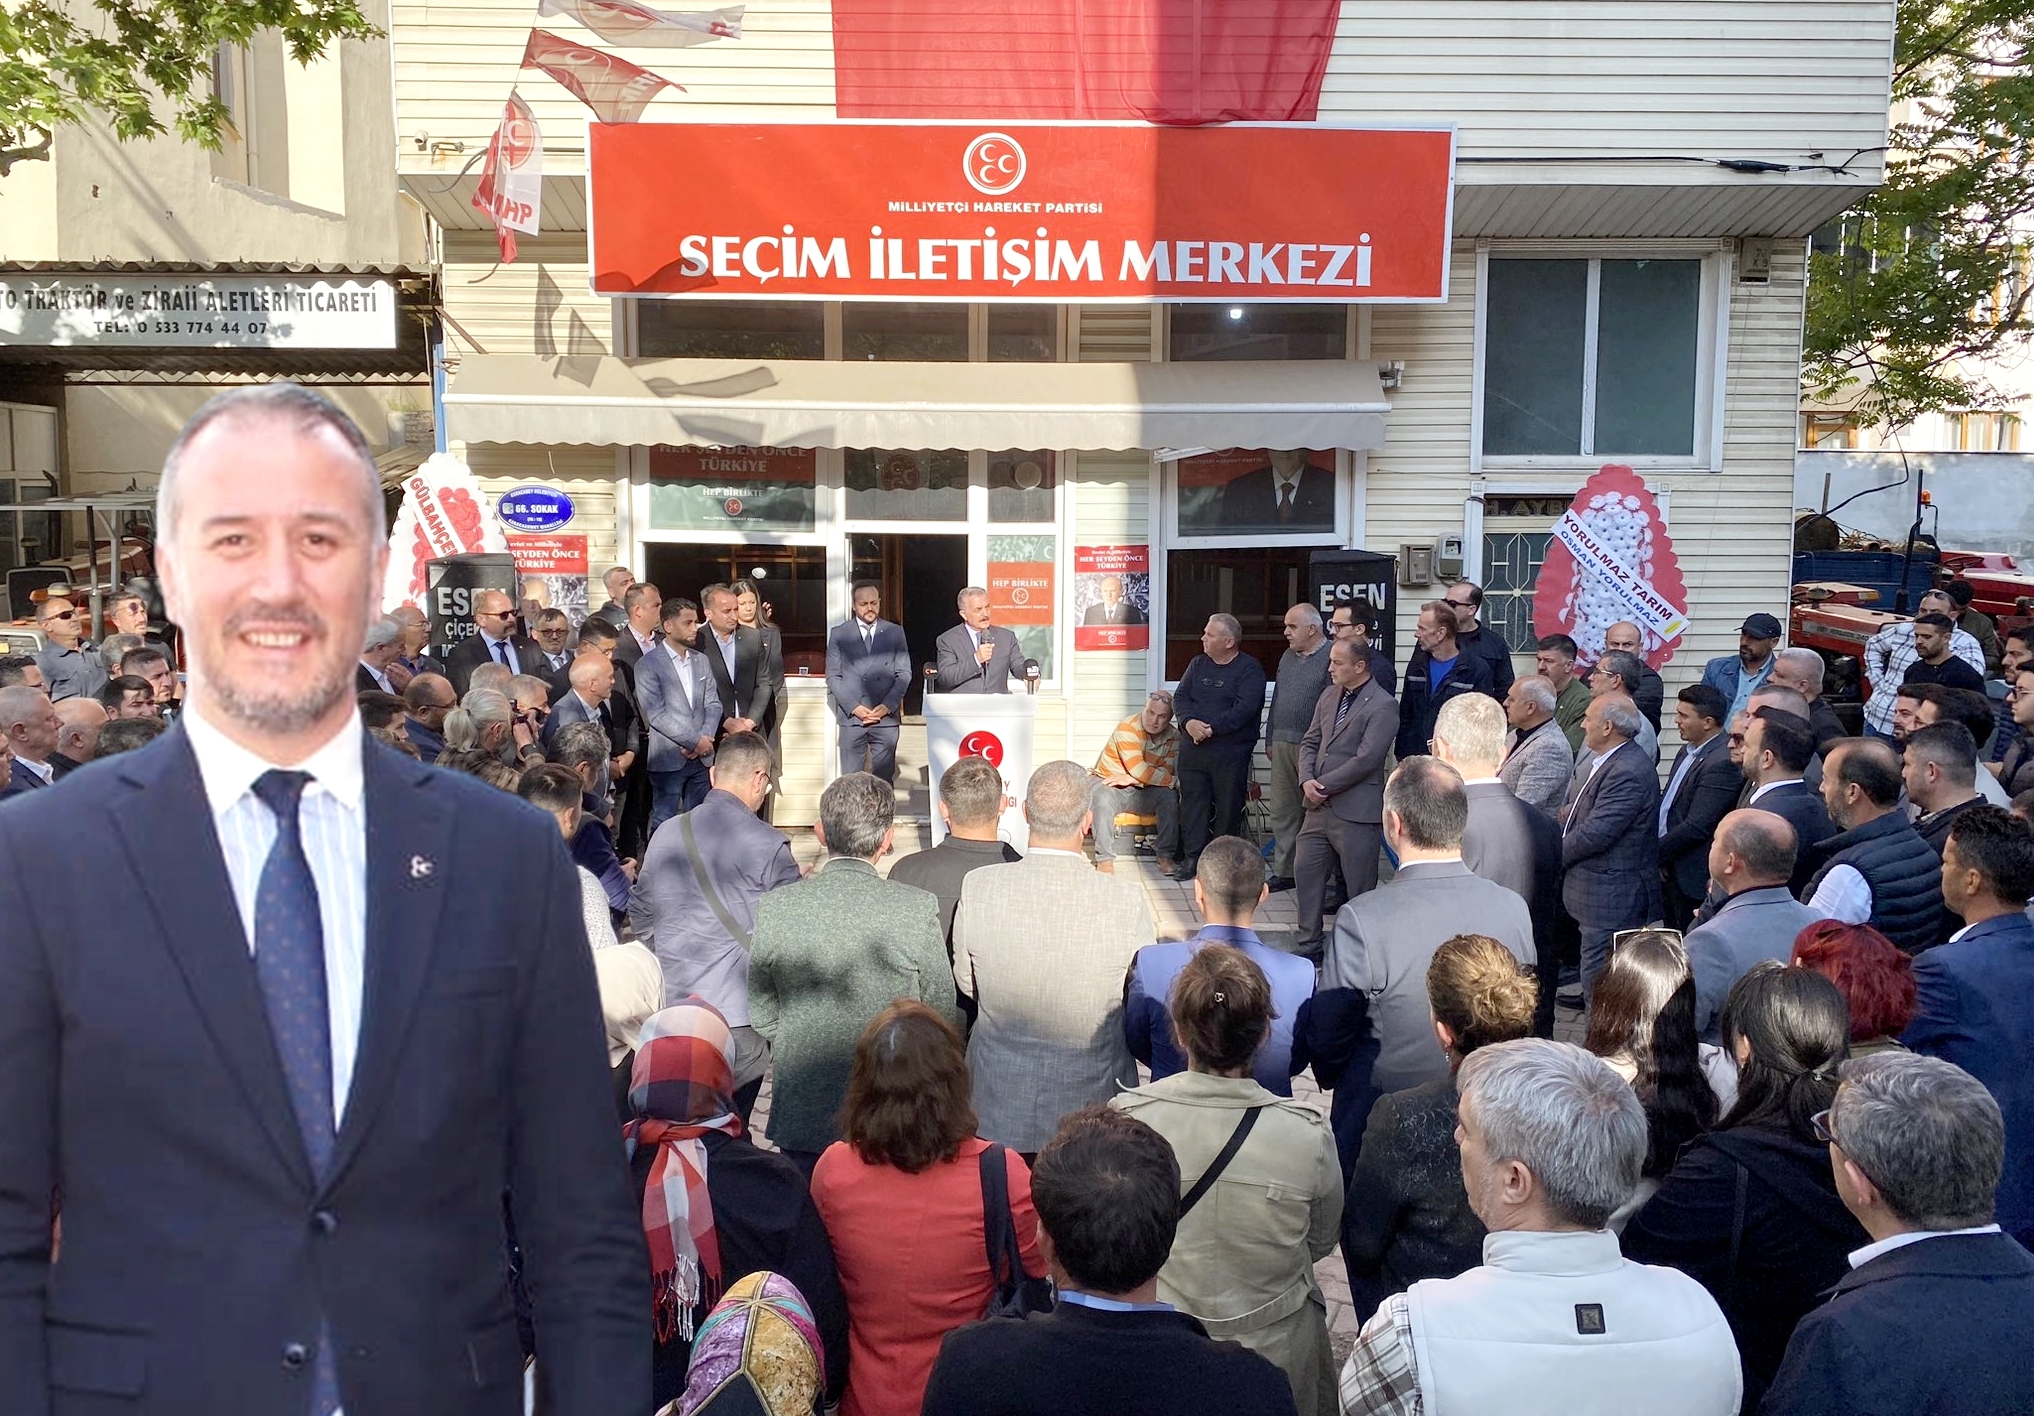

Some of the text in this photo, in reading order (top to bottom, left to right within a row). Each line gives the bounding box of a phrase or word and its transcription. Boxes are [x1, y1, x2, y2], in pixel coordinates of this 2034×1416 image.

[973, 202, 1041, 214] HAREKET
[679, 224, 1372, 288] SEÇİM İLETİŞİM MERKEZİ
[25, 284, 108, 311] TRAKTÖR
[115, 294, 134, 311] ve
[205, 286, 290, 312] ALETLERİ
[296, 286, 378, 313] TİCARETİ
[94, 321, 129, 333] TEL:
[155, 321, 180, 333] 533
[187, 322, 214, 334] 774
[221, 322, 241, 334] 44
[248, 322, 268, 334] 07
[699, 457, 767, 473] TÜRKİYE
[702, 488, 721, 497] HEP
[515, 504, 559, 514] 66. SOKAK
[551, 547, 581, 560] ÖNCE
[1563, 514, 1674, 621] YORULMAZ TARIM
[992, 578, 1010, 587] HEP
[1560, 530, 1660, 626] OSMAN YORULMAZ
